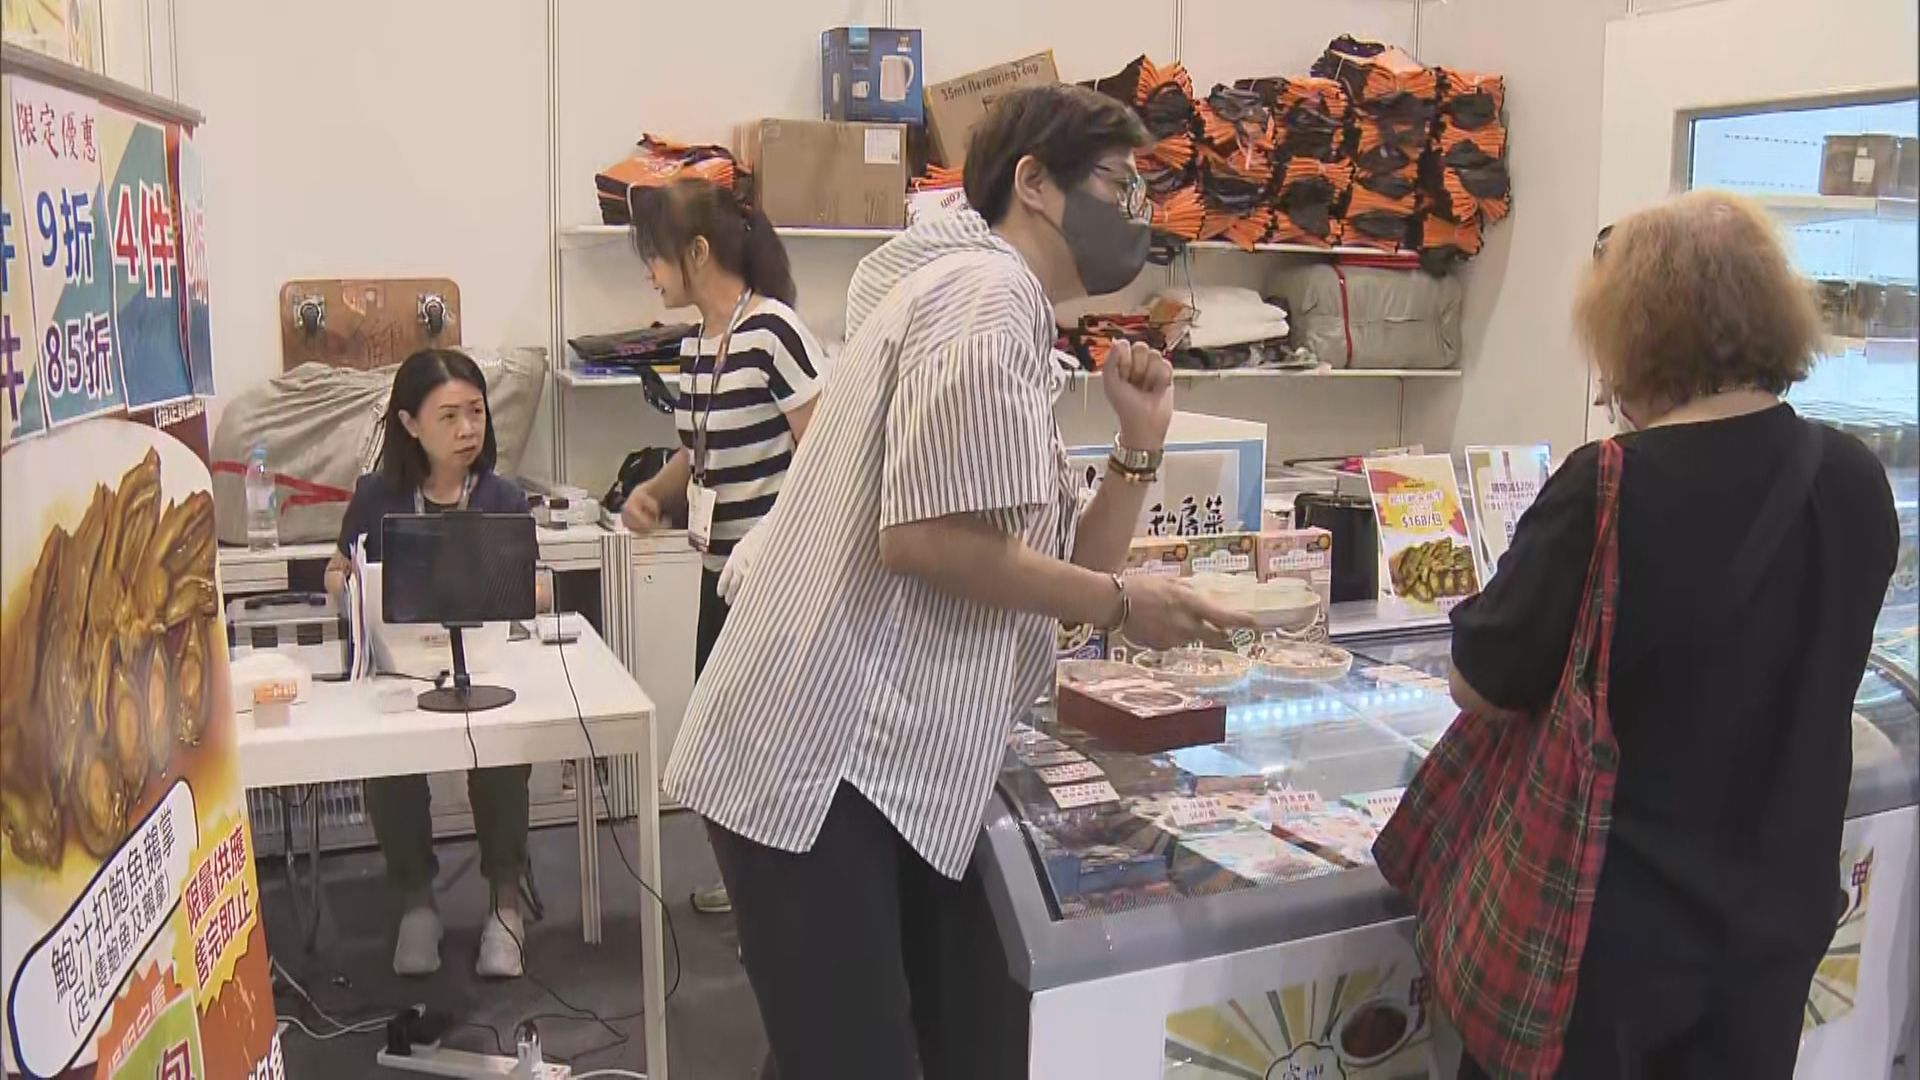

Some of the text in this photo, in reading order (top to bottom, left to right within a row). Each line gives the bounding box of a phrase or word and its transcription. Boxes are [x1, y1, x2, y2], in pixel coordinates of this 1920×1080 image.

[16, 103, 96, 163] 限定優惠
[36, 188, 93, 283] 9折
[115, 183, 176, 297] 4件
[45, 316, 113, 397] 85折
[1148, 495, 1224, 536] 私房菜
[51, 805, 175, 1003] 鮑汁扣鮑魚鵝掌
[184, 824, 246, 935] 限量供應
[194, 880, 252, 989] 售完即止
